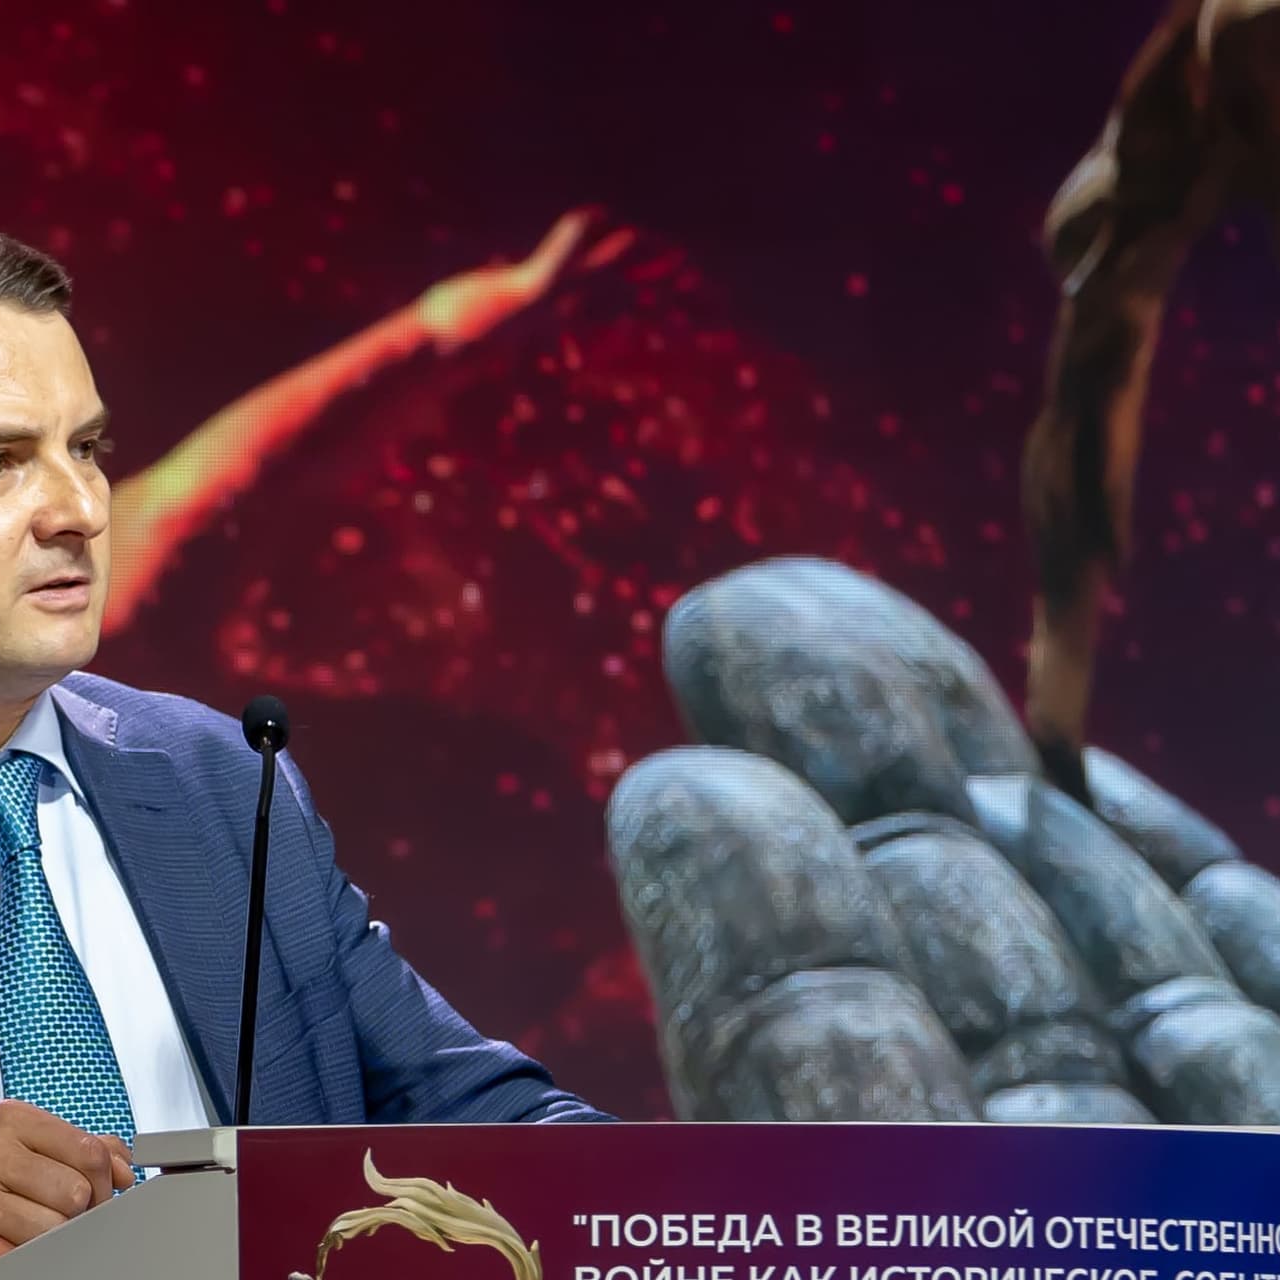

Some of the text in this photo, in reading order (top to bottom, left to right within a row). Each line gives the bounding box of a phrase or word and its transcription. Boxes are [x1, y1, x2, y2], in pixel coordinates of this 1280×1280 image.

[573, 1212, 784, 1254] "ПОБЕДА
[796, 1213, 824, 1247] В
[836, 1207, 1035, 1248] ВЕЛИКОЙ
